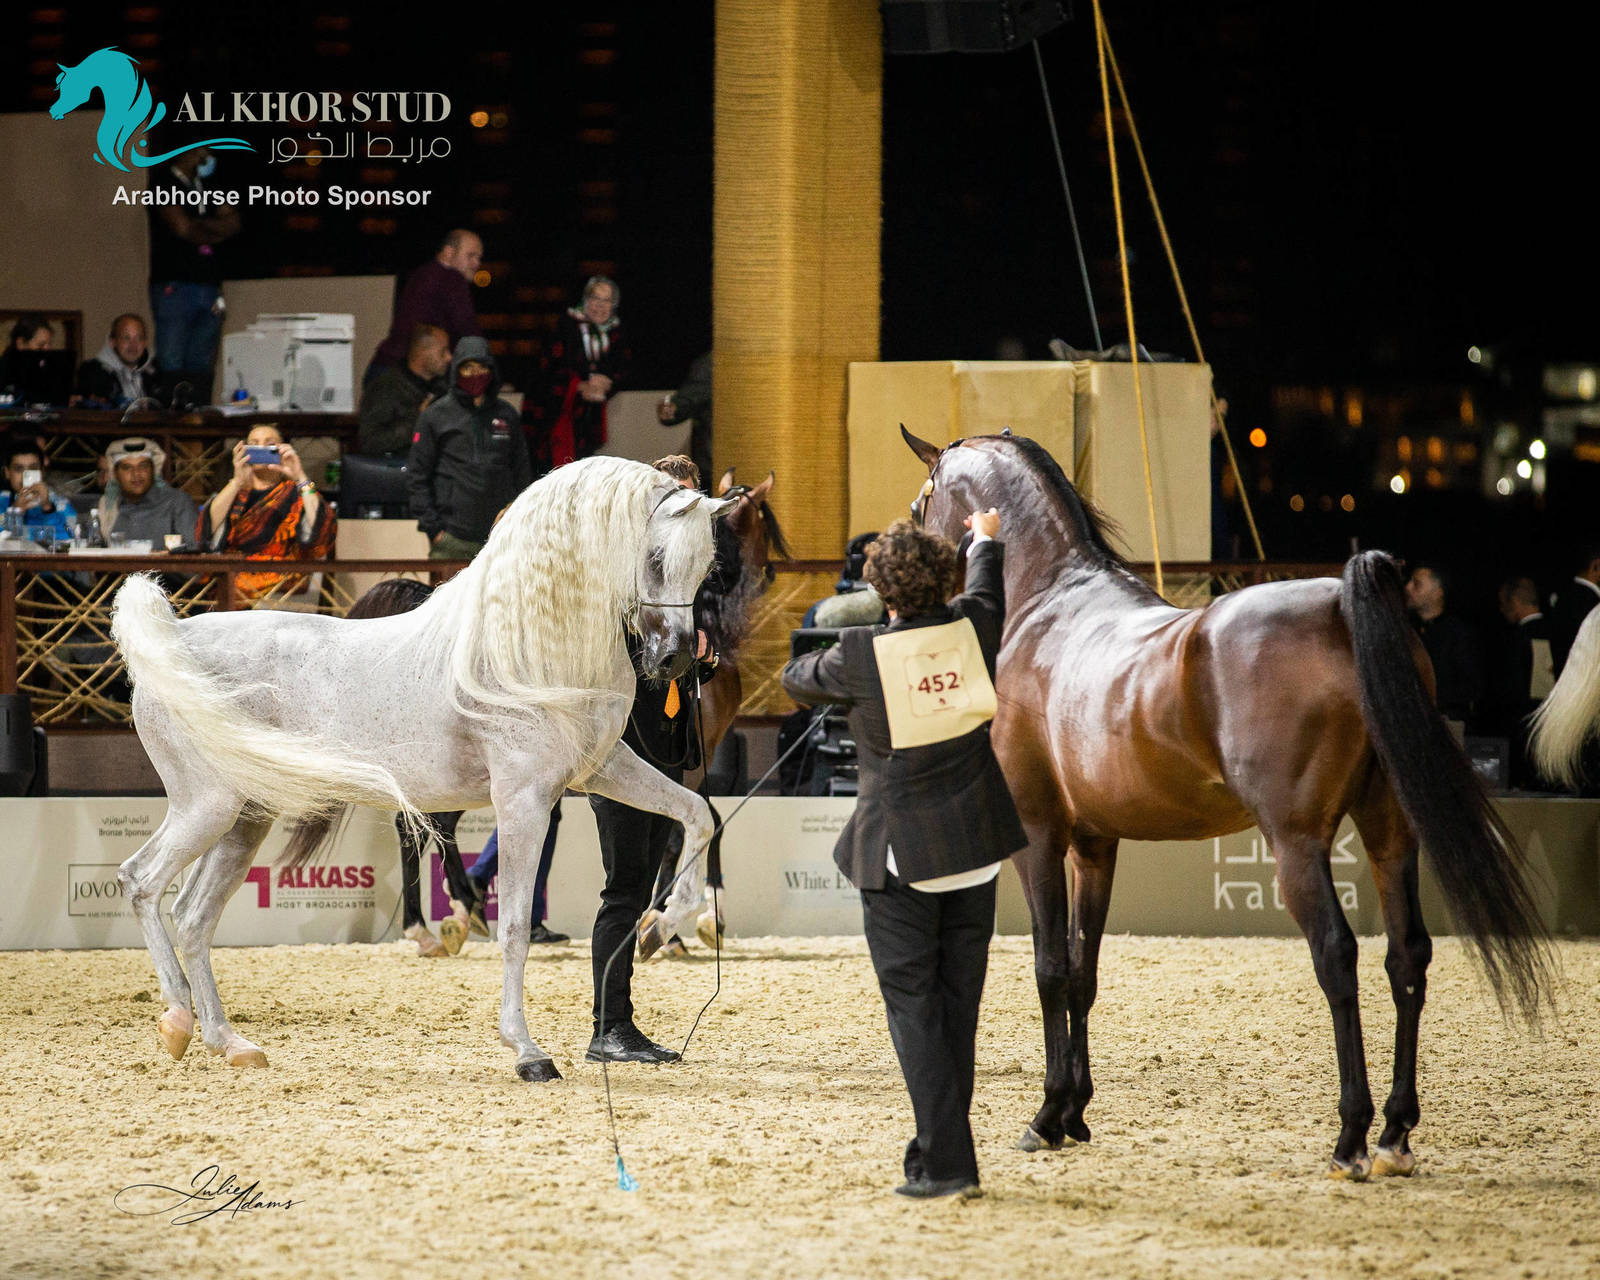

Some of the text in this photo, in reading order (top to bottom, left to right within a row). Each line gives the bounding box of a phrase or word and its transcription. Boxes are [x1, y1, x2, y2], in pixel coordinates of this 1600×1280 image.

[918, 671, 960, 694] 452
[99, 827, 122, 836] Bronze
[277, 865, 375, 888] ALKASS
[785, 871, 830, 890] White
[1214, 871, 1359, 910] kata
[276, 901, 375, 909] HOST BROADCASTER
